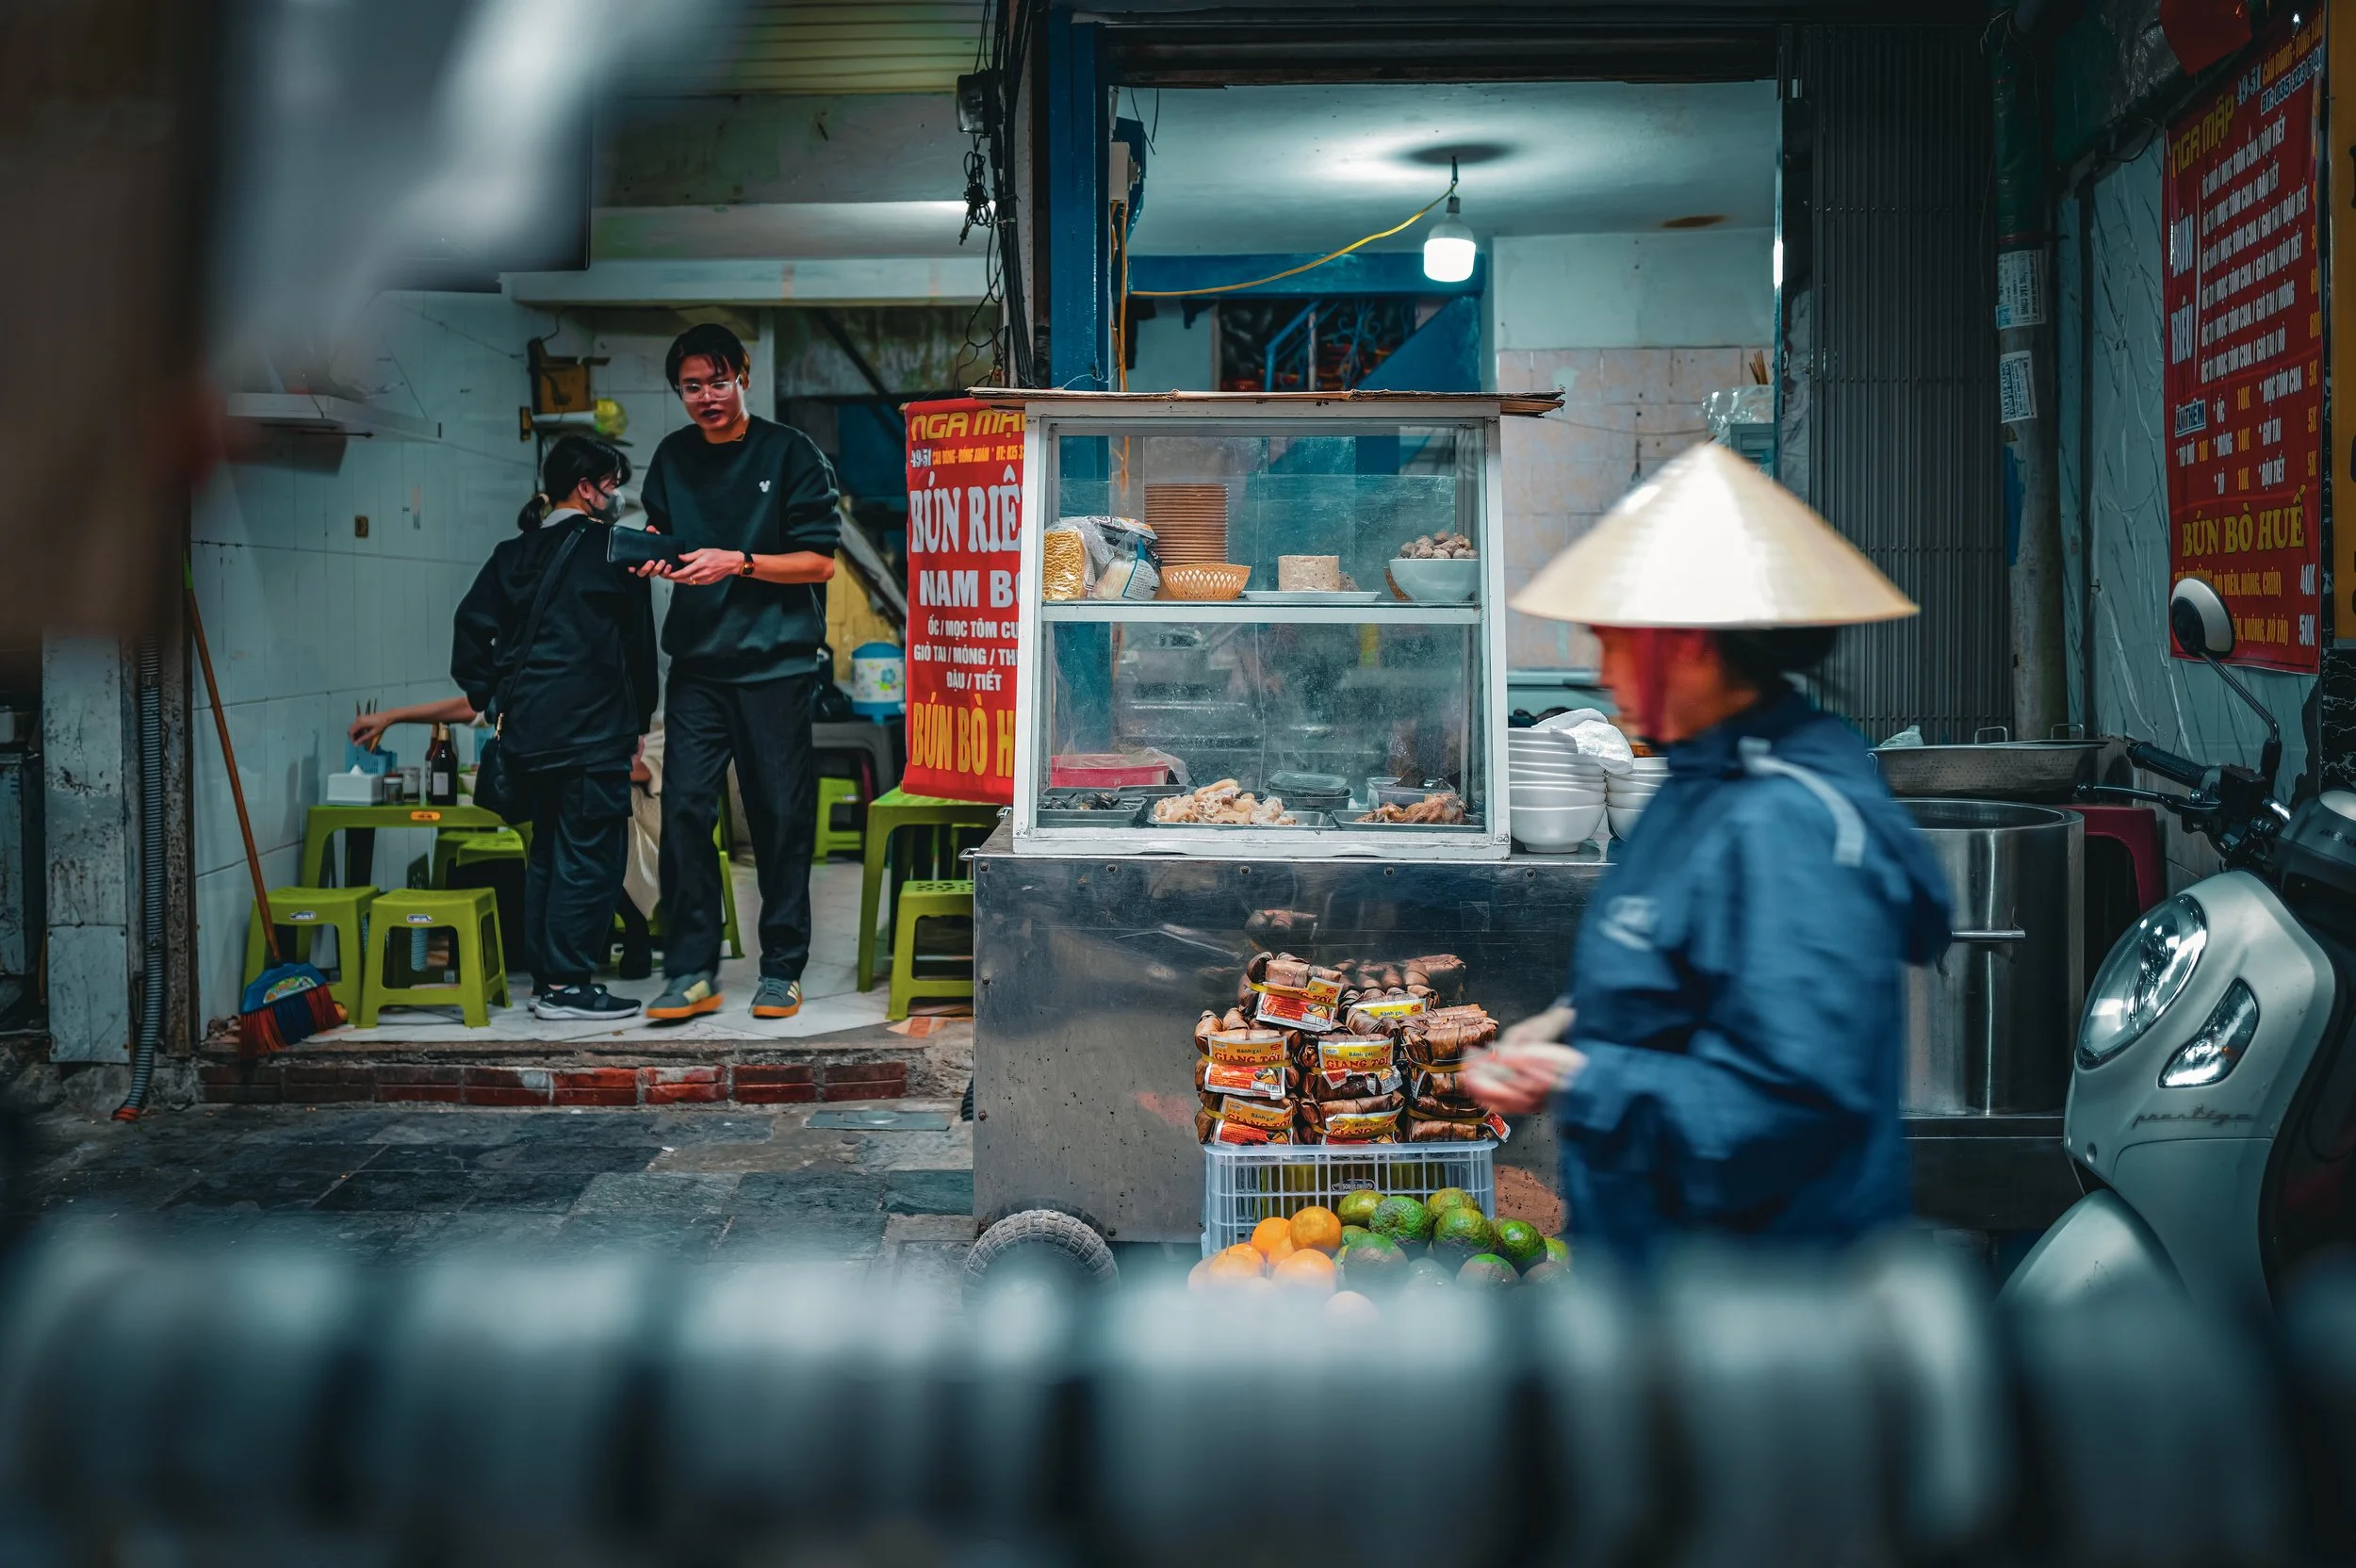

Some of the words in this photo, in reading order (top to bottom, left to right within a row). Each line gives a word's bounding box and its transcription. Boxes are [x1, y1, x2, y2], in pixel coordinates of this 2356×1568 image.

[2239, 302, 2251, 329] CUA
[2239, 342, 2252, 368] CUA
[2289, 366, 2301, 394] CUA
[2309, 359, 2317, 387] 5K
[2237, 385, 2250, 412] 10K
[911, 411, 969, 442] NGA
[2237, 426, 2250, 452] 10K
[910, 448, 932, 467] 49-51
[2237, 466, 2250, 491] 10K
[909, 471, 961, 553] BÚN
[968, 465, 1023, 553] RIÊ
[2182, 510, 2219, 557] BÚN
[2223, 502, 2253, 554] BÒ
[2256, 484, 2307, 551] HUẾ
[919, 570, 979, 608] NAM
[990, 570, 1021, 608] B
[2299, 564, 2315, 596] 40K
[927, 613, 940, 636] ỐC
[945, 618, 968, 641] MỌC
[970, 617, 997, 638] TÔM
[1001, 621, 1019, 639] CU
[2299, 614, 2315, 646] 50K
[913, 642, 932, 662] GIÒ
[933, 645, 947, 662] TAI
[953, 644, 987, 665] MÓNG
[946, 670, 965, 692] ĐẬU
[973, 668, 1003, 692] TIẾT
[911, 692, 953, 771] BÚN
[957, 694, 989, 776] BÒ
[996, 710, 1016, 777] H
[1214, 1053, 1256, 1063] GIANG
[1326, 1059, 1367, 1069] GIANG
